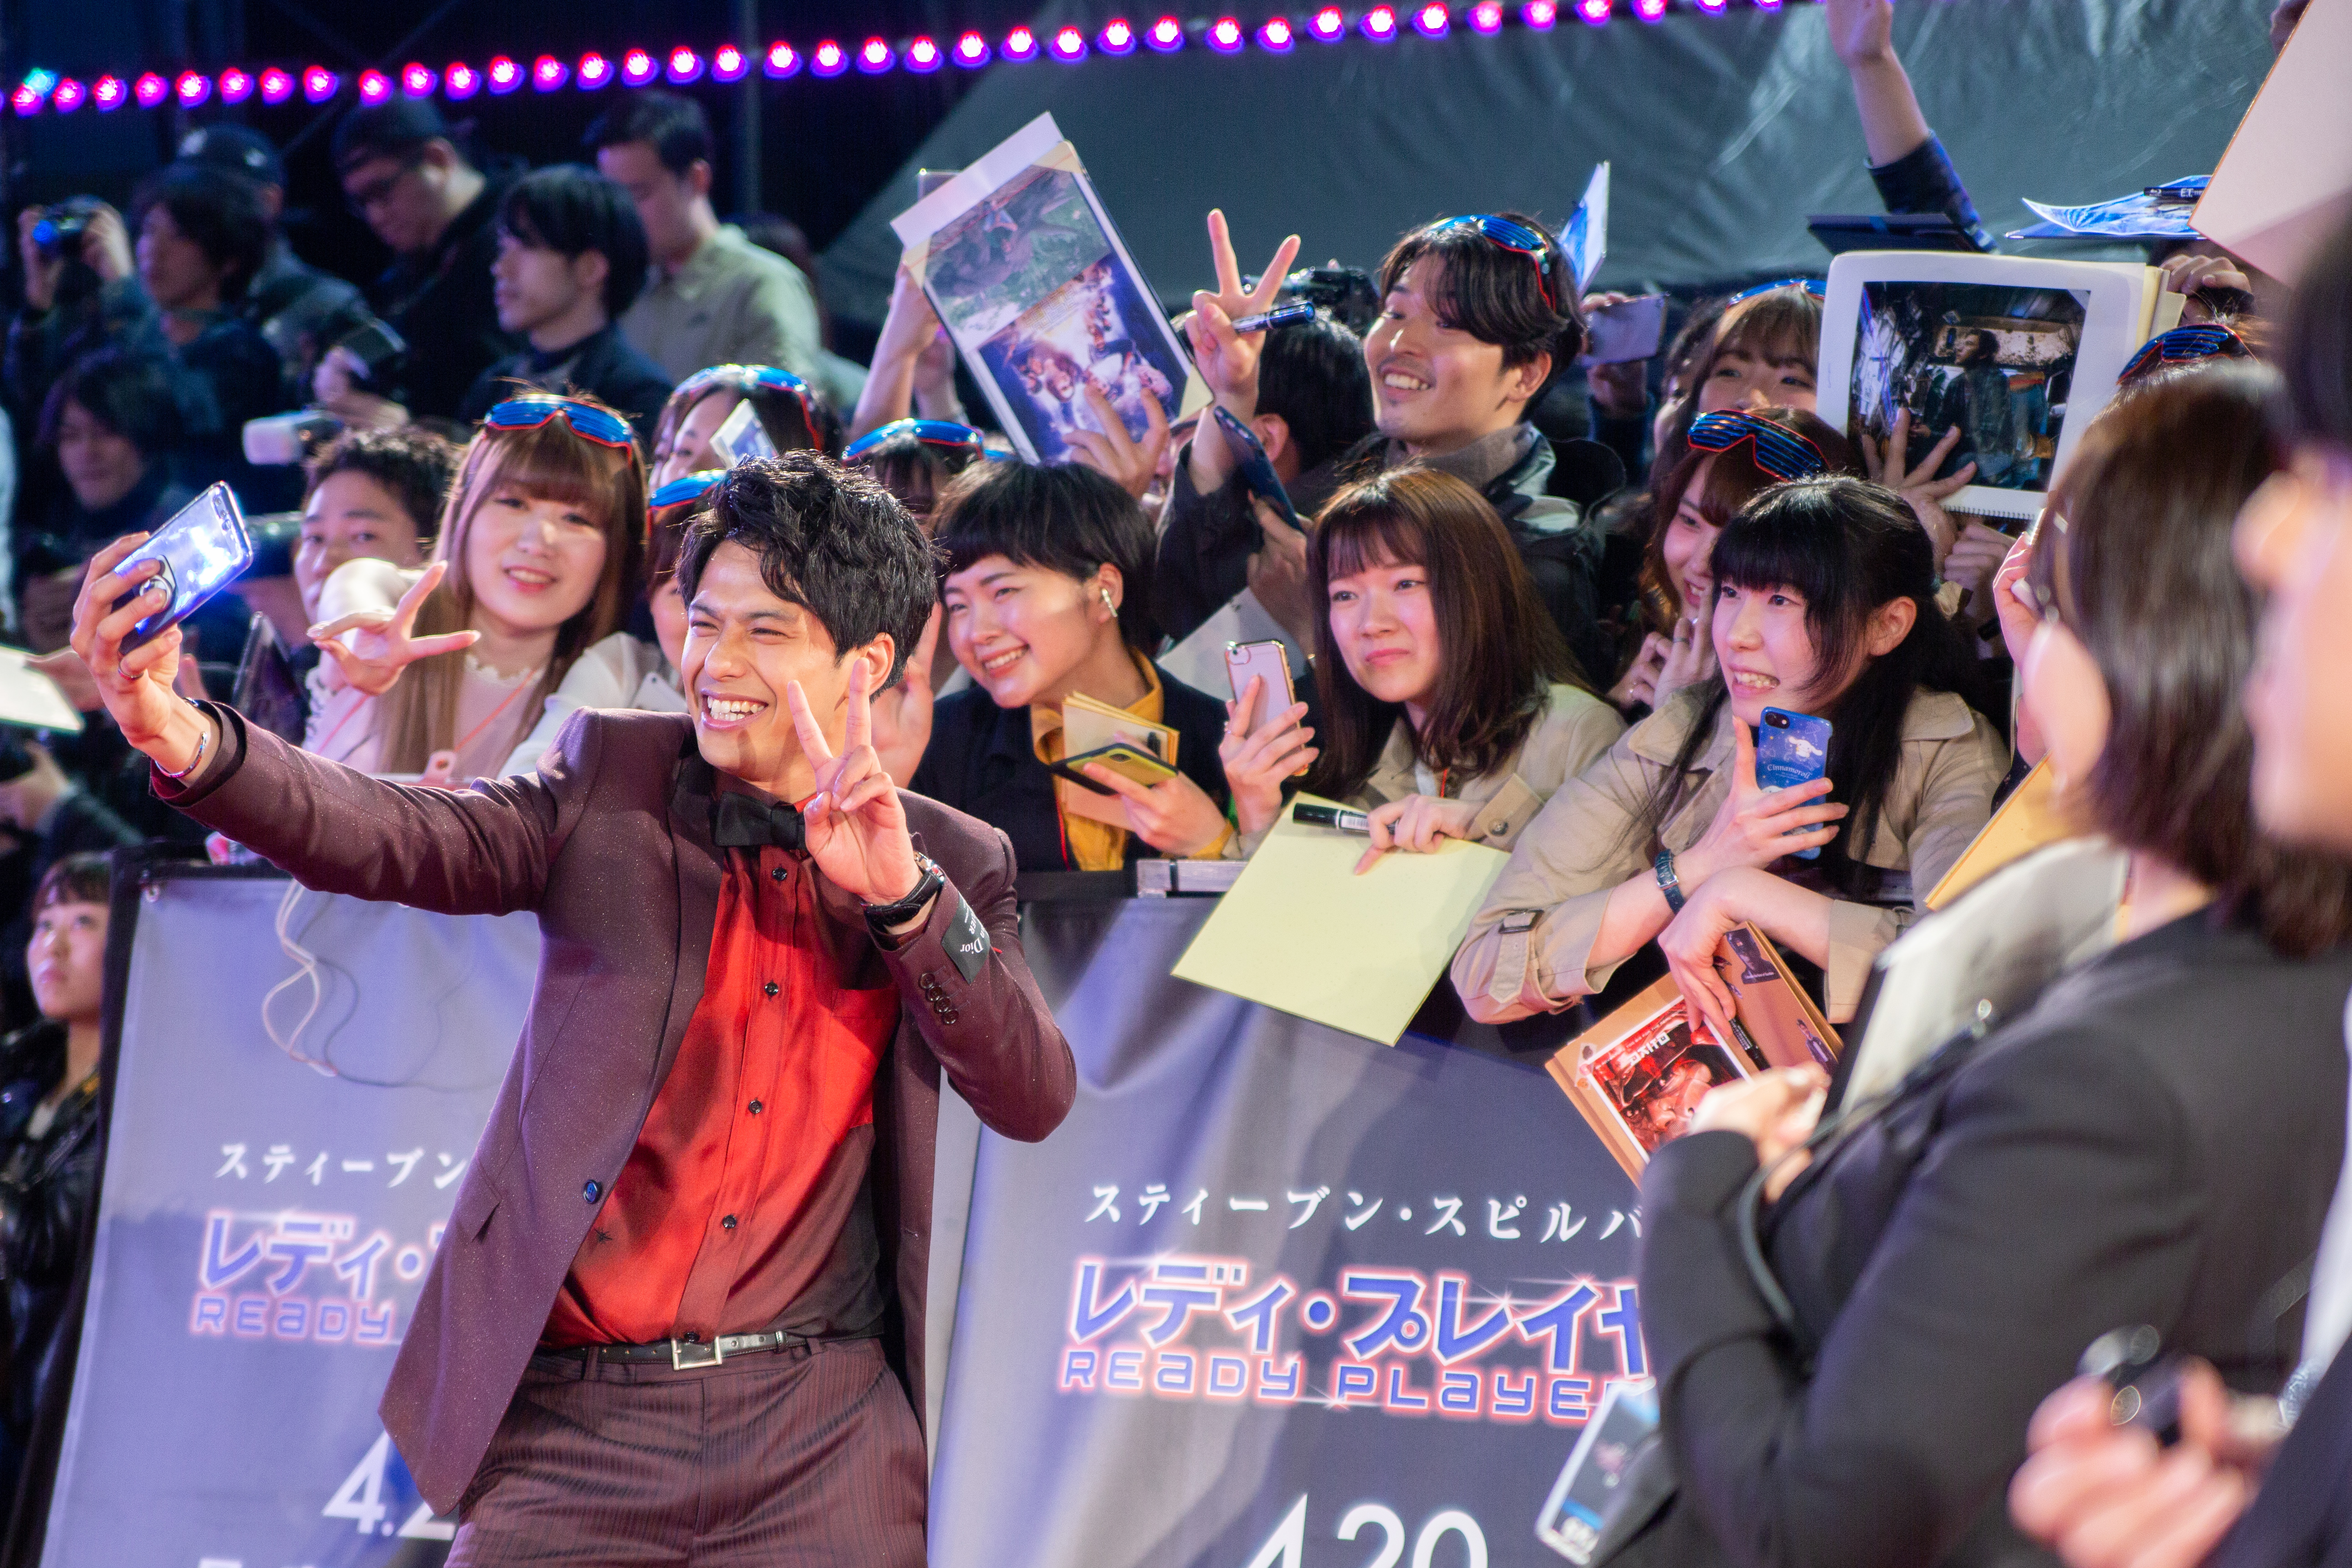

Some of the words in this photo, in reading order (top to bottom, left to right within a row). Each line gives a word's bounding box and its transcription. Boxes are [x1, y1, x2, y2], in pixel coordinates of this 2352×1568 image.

[1767, 764, 1813, 779] Cinnamoroll
[960, 937, 984, 954] Dior
[215, 1143, 467, 1189] スティーブン
[201, 1213, 447, 1302] レディ・
[1336, 1363, 1617, 1420] PLAYE
